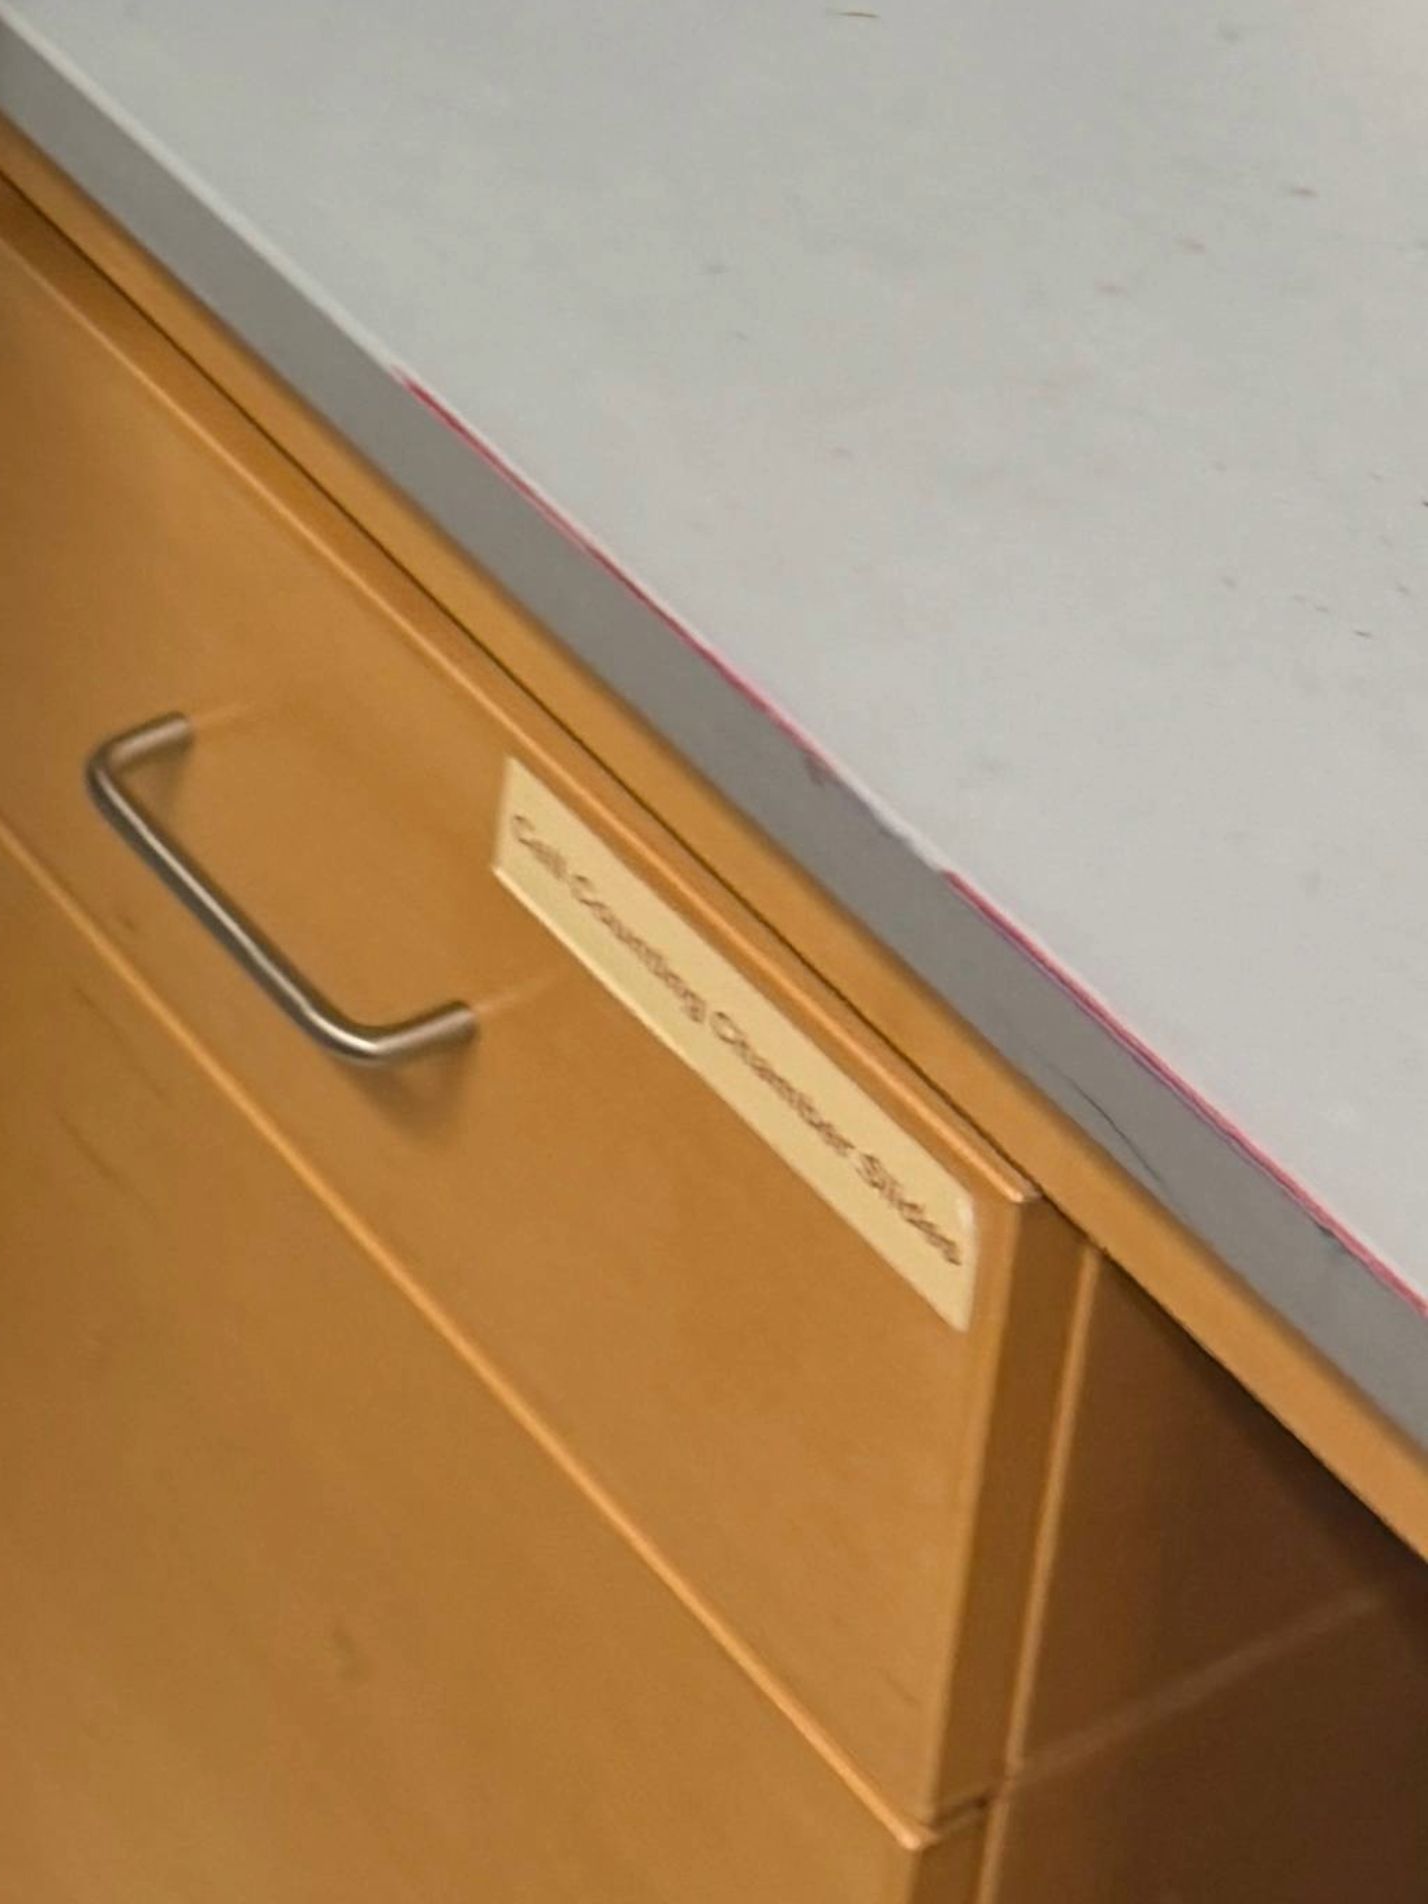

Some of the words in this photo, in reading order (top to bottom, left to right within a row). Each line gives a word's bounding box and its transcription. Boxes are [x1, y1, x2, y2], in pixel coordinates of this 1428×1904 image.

[511, 813, 567, 881] Cell
[568, 874, 709, 1024] Counting
[710, 1010, 855, 1158] Chamber
[855, 1152, 964, 1267] Slides
